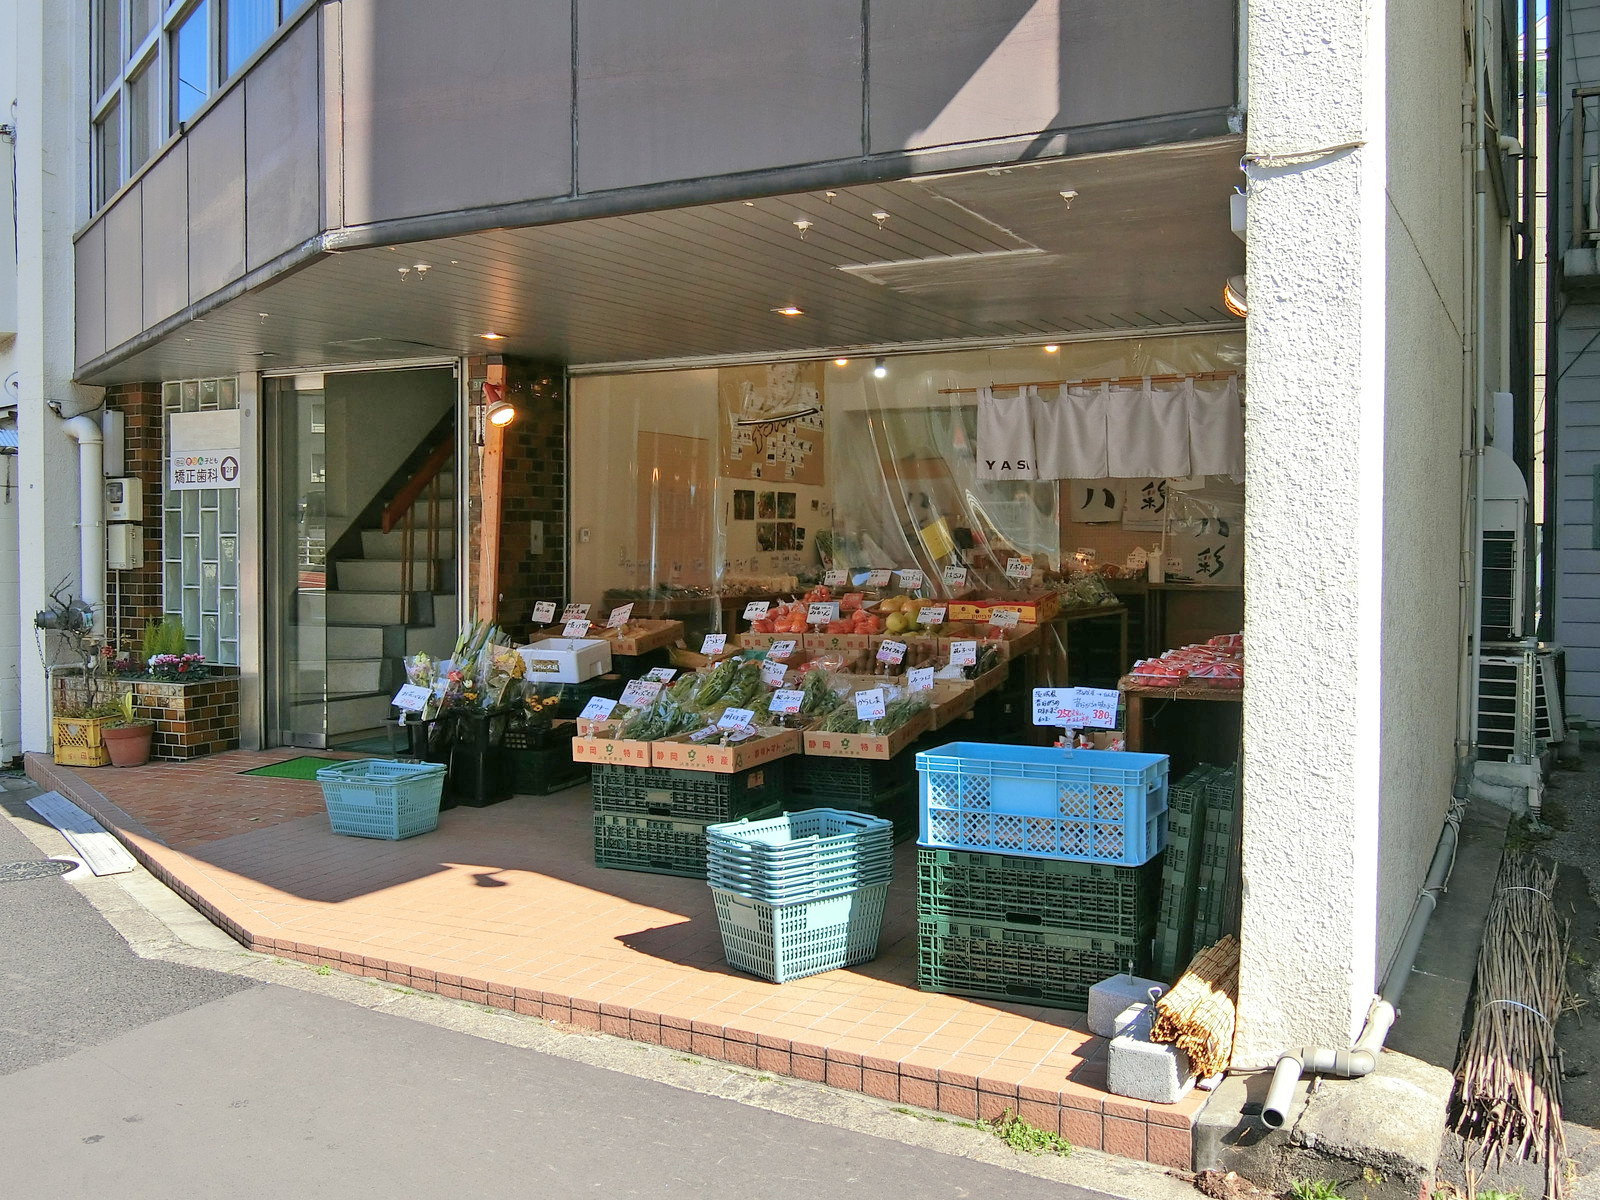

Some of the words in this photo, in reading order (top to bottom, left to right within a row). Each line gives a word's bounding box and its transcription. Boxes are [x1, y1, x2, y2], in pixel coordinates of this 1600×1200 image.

[175, 468, 218, 484] 矯正歯科
[809, 609, 830, 617] みかん
[1092, 709, 1110, 720] 380
[808, 739, 831, 749] 静岡
[860, 743, 884, 753] 特産
[577, 745, 597, 755] 静岡
[623, 748, 644, 759] 特産
[656, 751, 679, 761] 静岡
[706, 754, 729, 766] 特産
